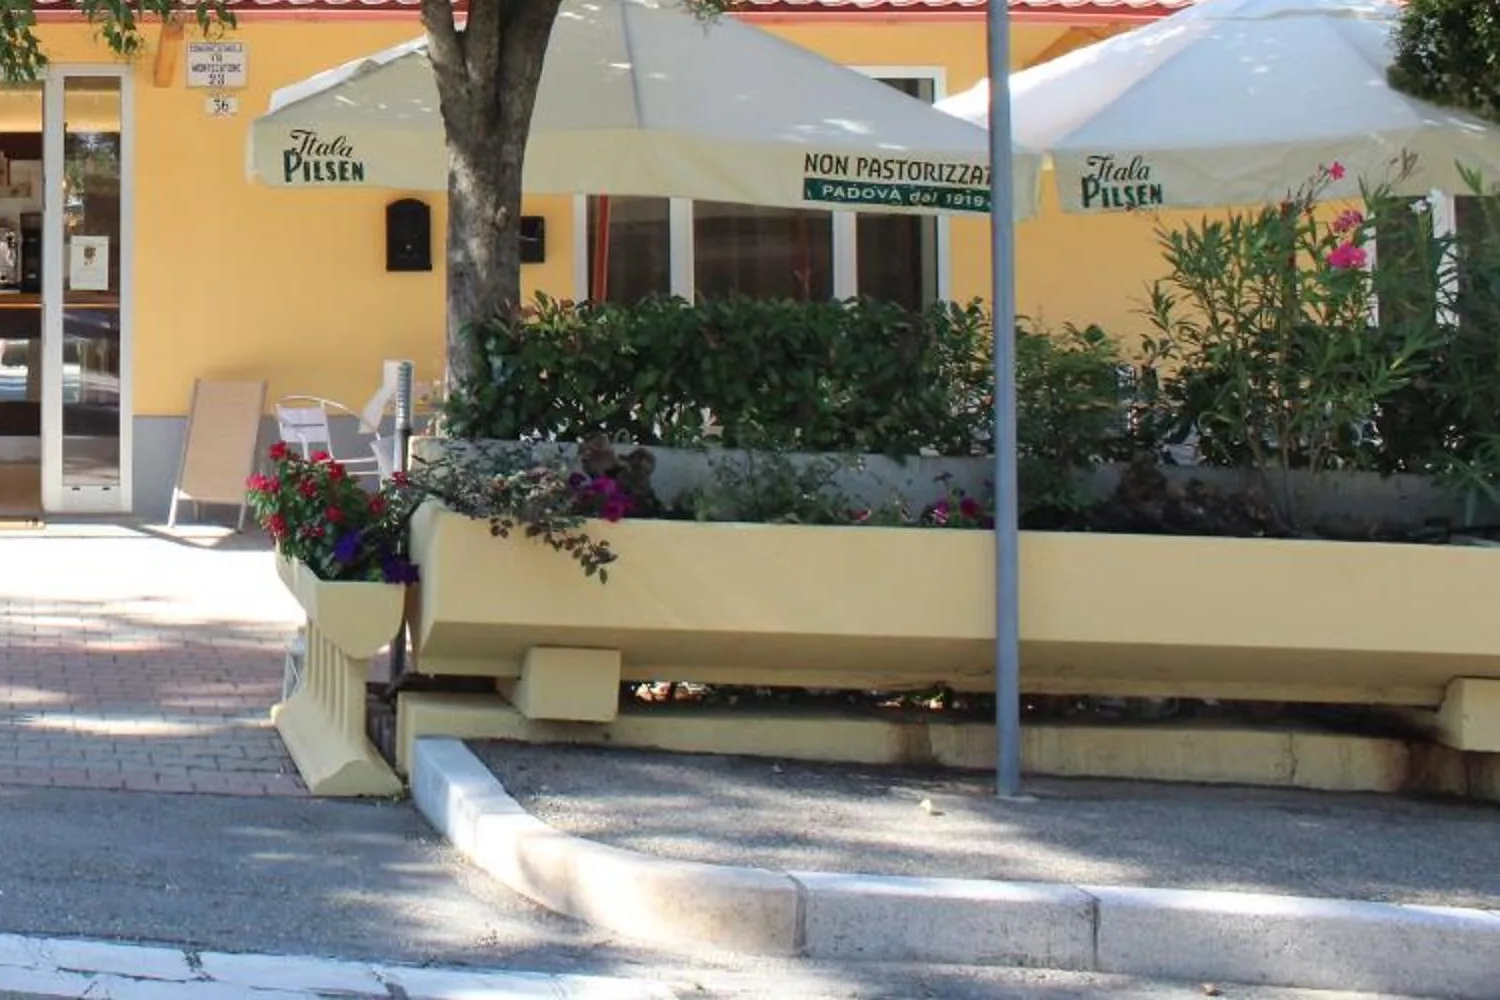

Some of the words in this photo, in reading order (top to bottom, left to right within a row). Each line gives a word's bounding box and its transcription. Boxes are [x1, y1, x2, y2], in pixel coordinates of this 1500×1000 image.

[804, 152, 849, 175] NON
[856, 157, 991, 186] PASTORIZZAT
[822, 184, 901, 200] PADOVA
[909, 190, 938, 205] dal
[946, 192, 985, 207] 1919
